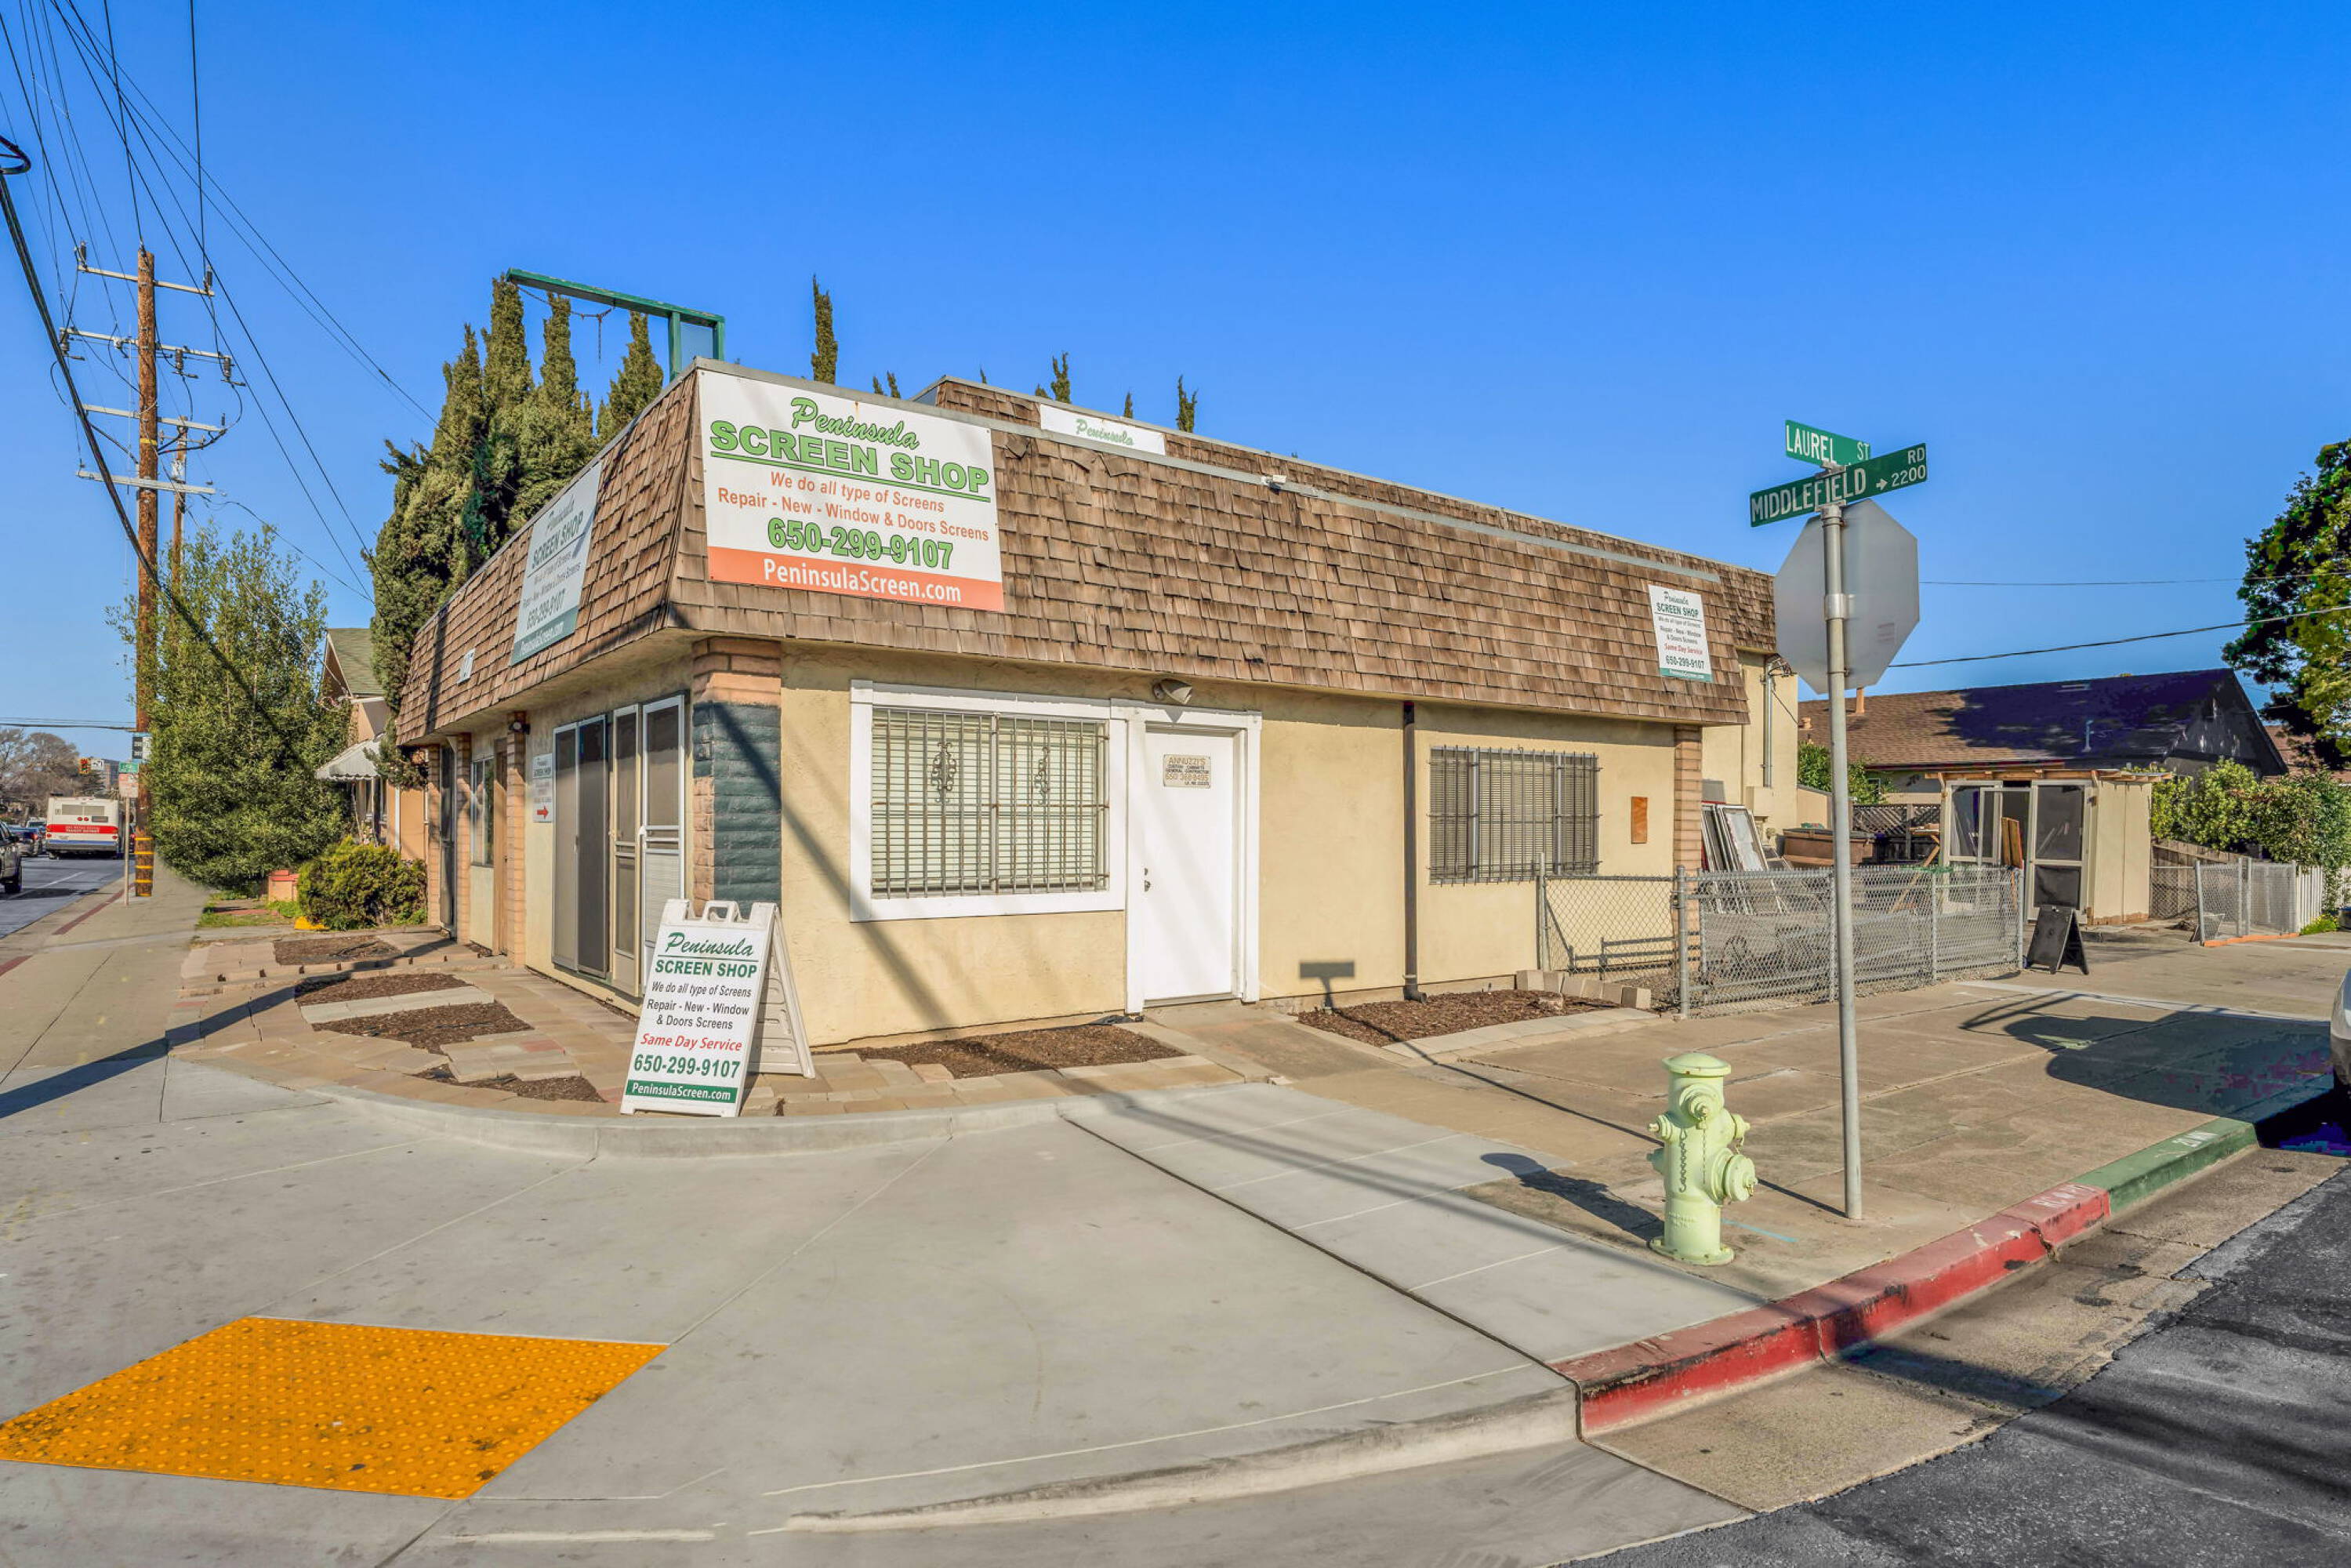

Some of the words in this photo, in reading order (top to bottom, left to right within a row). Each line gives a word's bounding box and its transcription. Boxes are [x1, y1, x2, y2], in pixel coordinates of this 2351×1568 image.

[790, 397, 920, 451] Peninsula
[1076, 419, 1134, 446] Peninsula
[709, 419, 878, 475] SCREEN
[891, 452, 989, 493] SHOP
[1785, 424, 1837, 463] LAUREL
[1856, 441, 1870, 461] ST
[1751, 468, 1867, 522] MIDDLEFIELD
[1907, 447, 1925, 464] RD
[1891, 466, 1926, 488] 2200
[771, 471, 793, 488] We
[798, 476, 815, 491] do
[820, 480, 836, 495] all
[842, 483, 870, 502] type
[875, 488, 889, 504] of
[893, 494, 945, 513] Screens
[561, 510, 584, 542] SHOP
[718, 487, 767, 510] Repair
[782, 496, 812, 515] New
[825, 503, 880, 524] Window
[884, 512, 894, 526] &
[898, 514, 936, 533] Doors
[940, 521, 989, 542] Screens
[767, 517, 953, 570] 650-299-9107
[764, 558, 962, 602] PeninsulaScreen.com
[1656, 602, 1682, 615] SCREEN
[1682, 607, 1699, 618] SHOP
[665, 931, 753, 956] Peninsula
[655, 960, 713, 975] SCREEN
[717, 963, 757, 978] SHOP
[651, 981, 664, 992] We
[666, 982, 676, 993] do
[677, 983, 688, 993] all
[690, 984, 706, 997] type
[709, 985, 718, 996] of
[720, 986, 752, 997] Screens
[647, 999, 677, 1012] Repair
[684, 1001, 705, 1012] New
[713, 1003, 749, 1015] Window
[656, 1014, 663, 1025] &
[666, 1014, 693, 1027] Doors
[696, 1017, 733, 1029] Screens
[640, 1033, 672, 1047] Same
[675, 1035, 698, 1051] Day
[700, 1037, 742, 1051] Service
[634, 1054, 741, 1079] 650-299-9107
[632, 1083, 731, 1101] PeninsulaScreen.com
